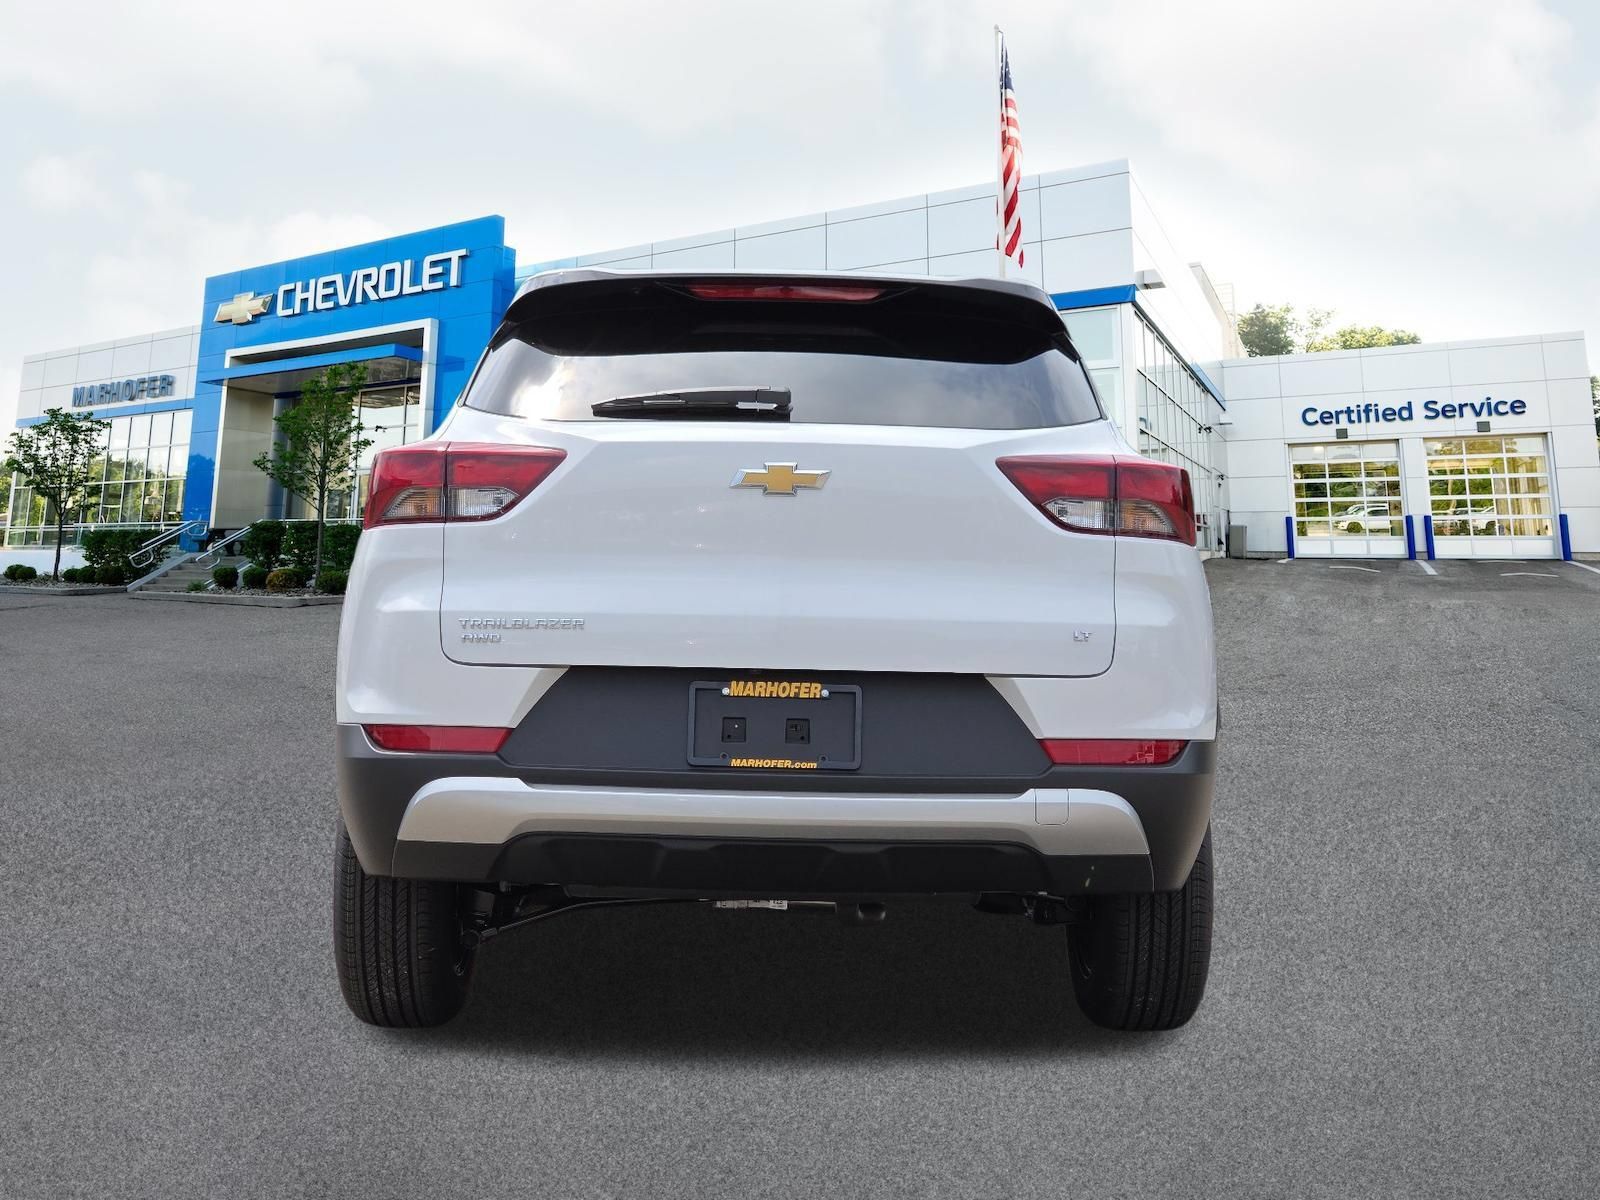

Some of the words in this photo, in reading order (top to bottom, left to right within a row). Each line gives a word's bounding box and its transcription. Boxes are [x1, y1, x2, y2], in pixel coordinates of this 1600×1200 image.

[277, 248, 468, 317] CHEVROLET
[72, 374, 175, 407] MARHOFER
[1301, 401, 1414, 426] Certified
[1423, 396, 1527, 420] Service
[458, 617, 585, 631] TRAILBLAZER
[461, 632, 502, 643] AWD
[1073, 630, 1093, 643] LT
[729, 680, 822, 698] MARHOFER
[730, 758, 818, 769] MARHOFER.com
